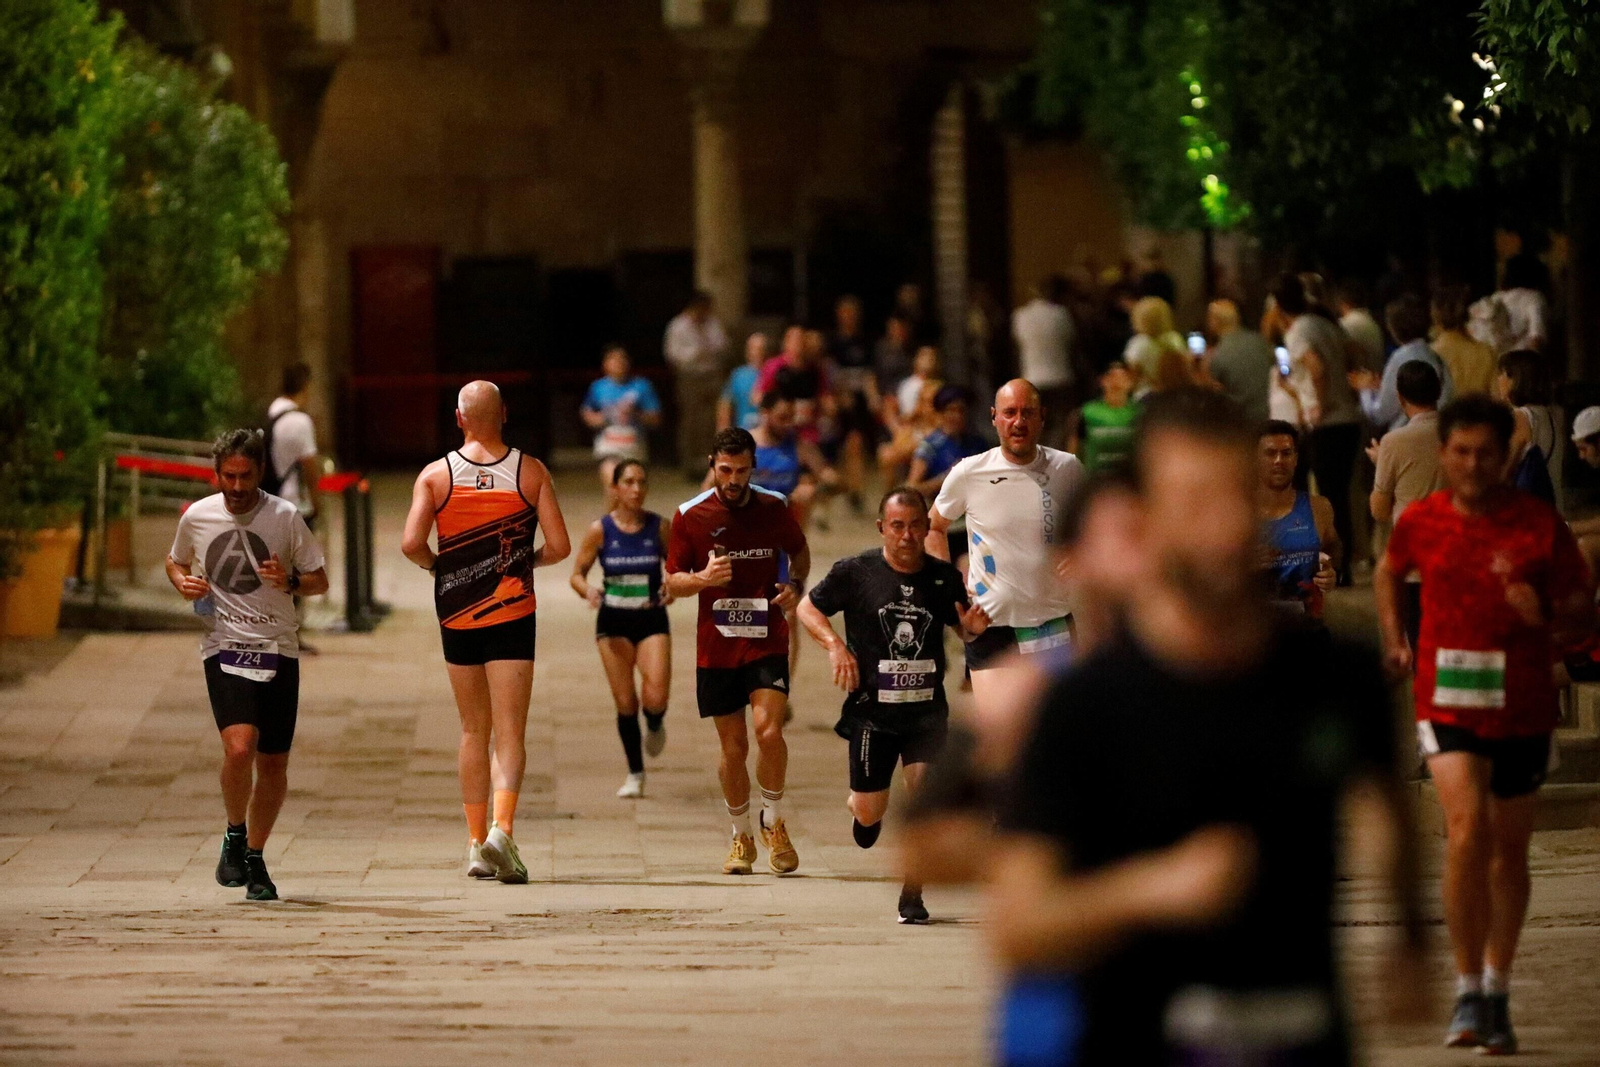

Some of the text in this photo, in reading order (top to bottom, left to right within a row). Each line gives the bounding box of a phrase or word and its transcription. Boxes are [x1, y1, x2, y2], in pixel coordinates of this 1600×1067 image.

[1042, 490, 1053, 544] ADICOR
[728, 611, 753, 622] 836
[235, 652, 261, 665] 724
[892, 673, 926, 687] 1085
